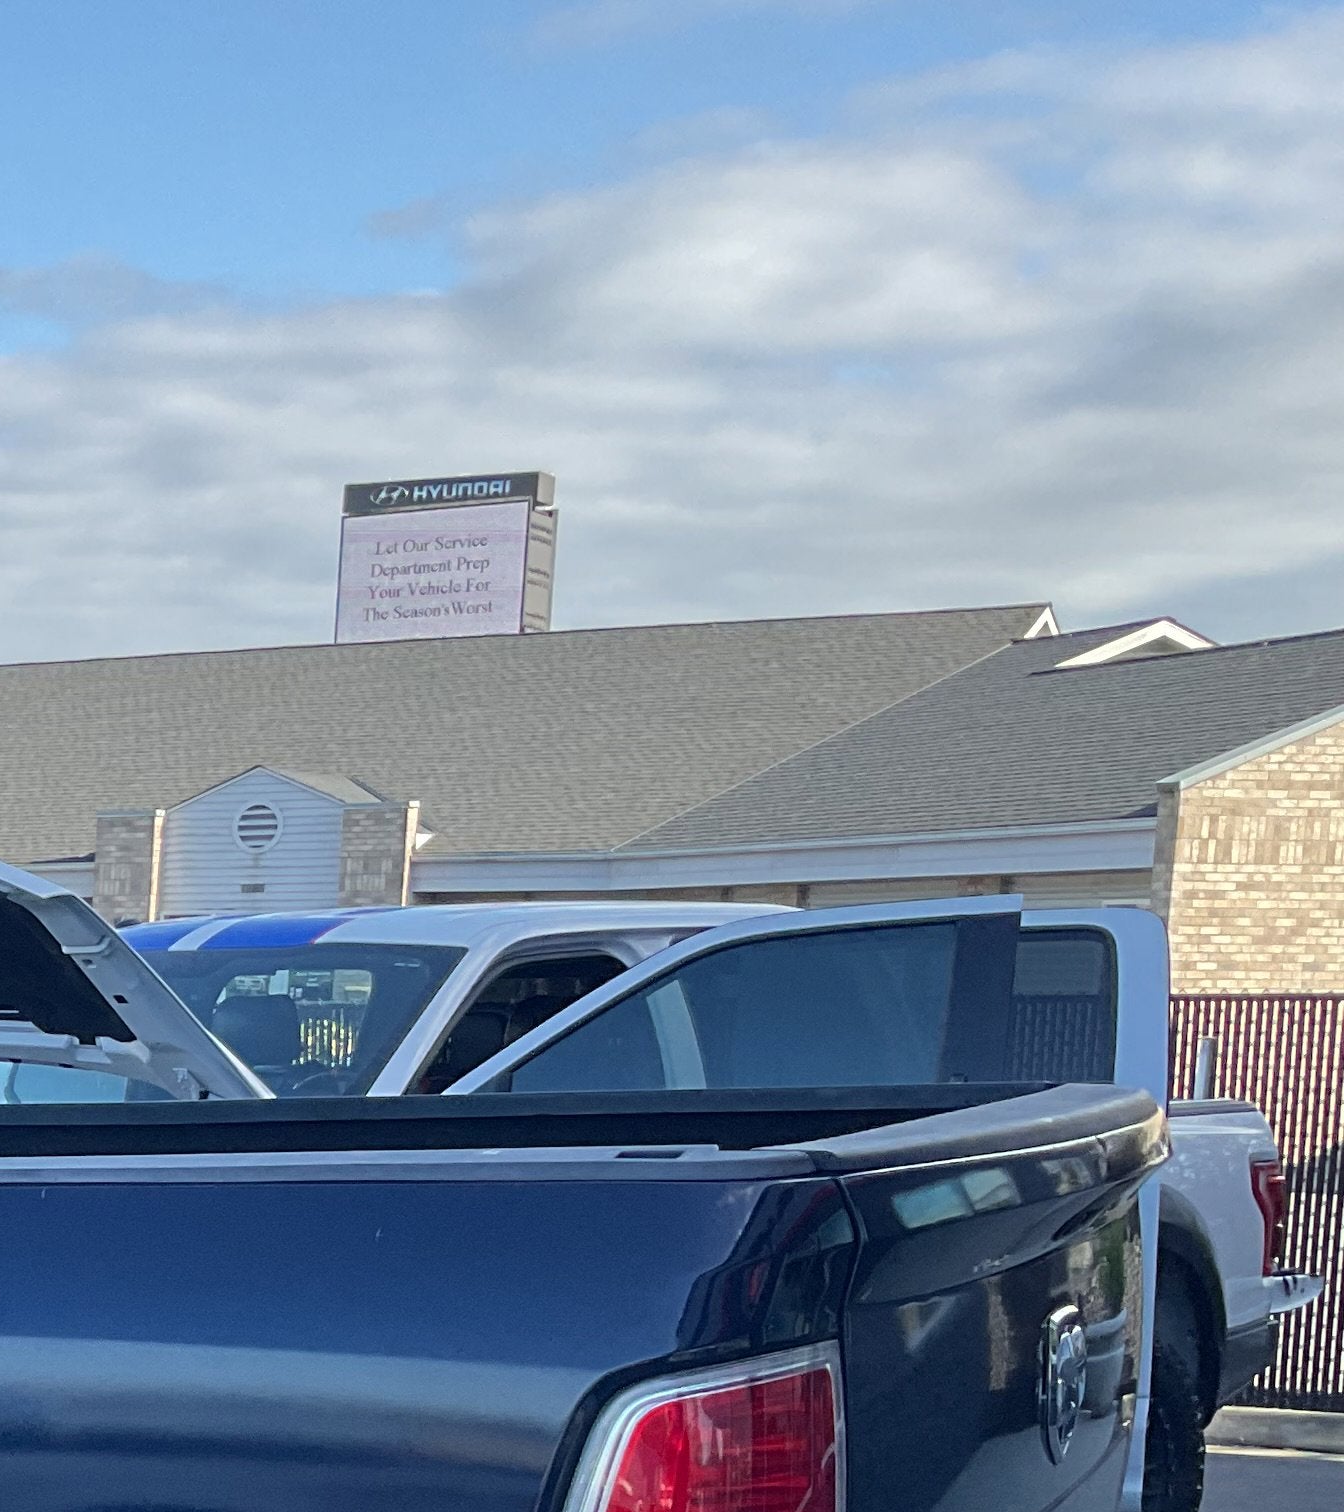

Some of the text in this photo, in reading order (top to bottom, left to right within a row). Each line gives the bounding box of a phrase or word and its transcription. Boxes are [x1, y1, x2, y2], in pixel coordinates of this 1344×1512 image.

[413, 479, 511, 501] HYUNDAI
[375, 533, 488, 556] Let Our Service
[371, 556, 490, 580] Department Prep
[368, 578, 491, 600] Your Vehicle For
[362, 600, 492, 621] The Season's Worst
